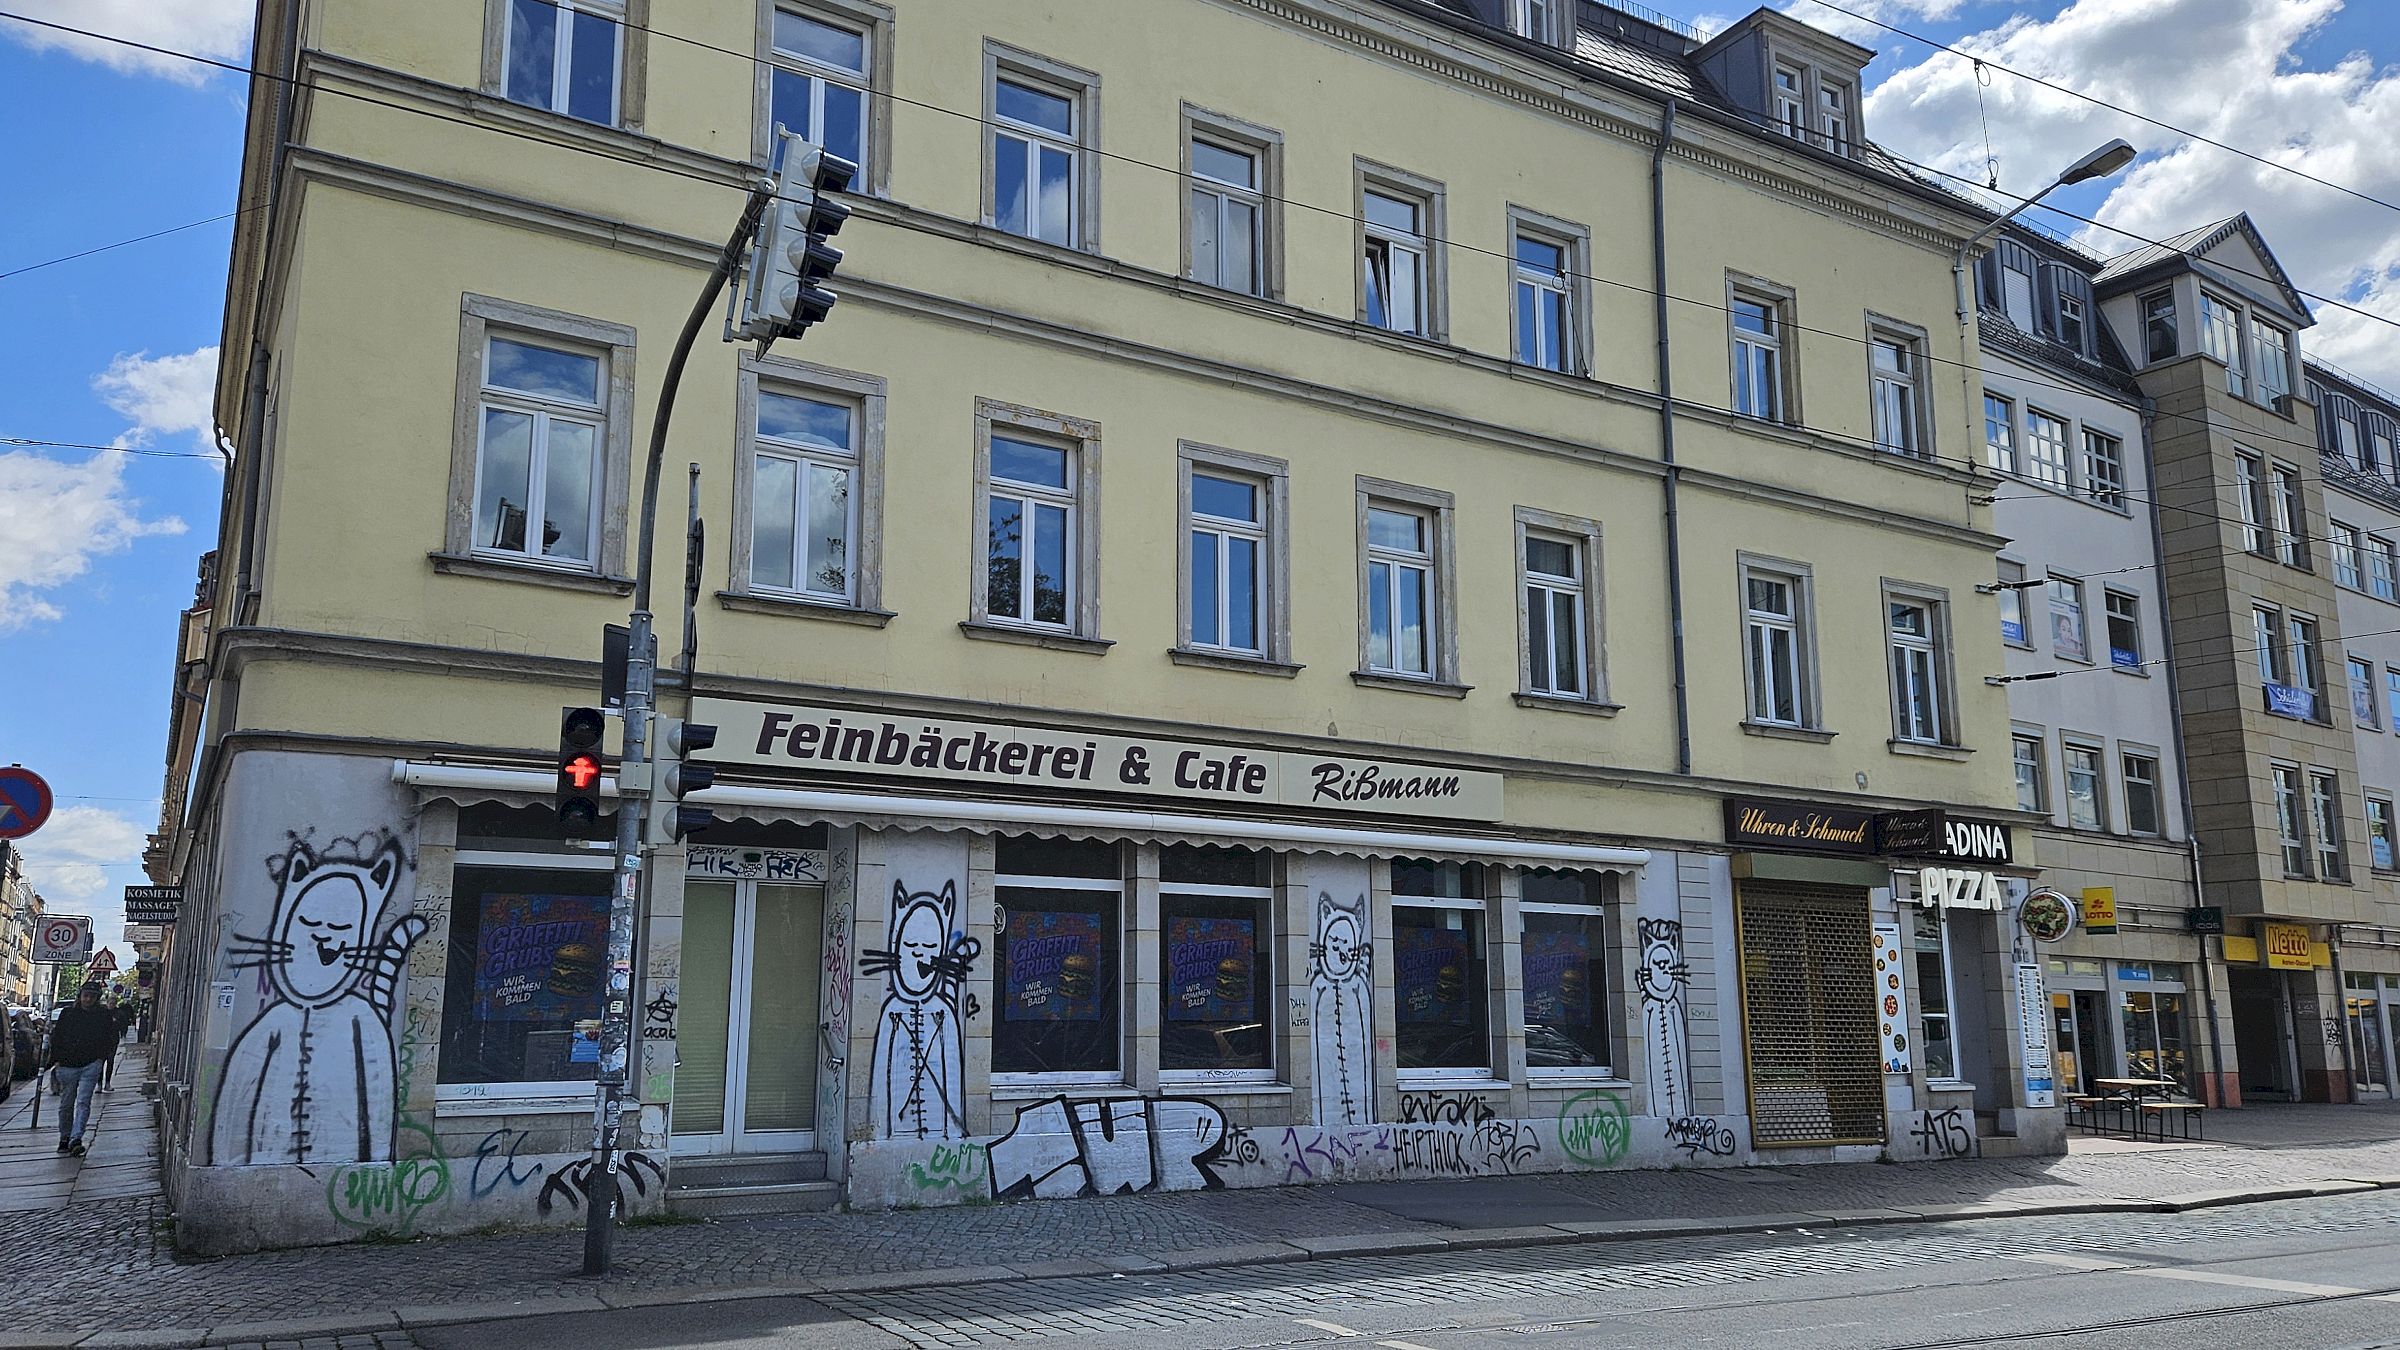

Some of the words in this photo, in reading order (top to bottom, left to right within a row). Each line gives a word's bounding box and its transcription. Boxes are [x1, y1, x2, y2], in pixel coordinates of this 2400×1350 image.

[755, 711, 1098, 781] Feinbäckerei
[1109, 746, 1151, 785] &
[1174, 750, 1267, 794] Cafe
[1311, 762, 1461, 802] Rißmann
[1739, 807, 1785, 837] Uhren
[1787, 819, 1800, 838] &
[1800, 812, 1869, 844] Schmuck
[126, 888, 182, 899] KOSMETIK
[1920, 866, 2003, 911] PIZZA
[2085, 911, 2114, 920] LOTTO
[51, 928, 72, 942] 30
[486, 922, 583, 953] GRAFFITI
[2268, 926, 2309, 957] Netto
[45, 951, 72, 959] ZONE
[1012, 935, 1081, 964] GRAFFITI
[1172, 940, 1235, 965] GRAFFITI
[485, 946, 555, 978] GRUBS
[1012, 956, 1061, 985] GRUBS
[1174, 960, 1217, 986] GRUBS
[503, 975, 526, 987] WIR
[1025, 981, 1042, 991] WIR
[1186, 983, 1201, 992] WIR
[496, 981, 541, 998] KOMMEN
[1021, 986, 1053, 1000] KOMMEN
[1182, 988, 1211, 1001] KOMMEN
[505, 993, 531, 1006] BALD
[1028, 995, 1046, 1007] BALD
[1188, 997, 1206, 1008] BALD
